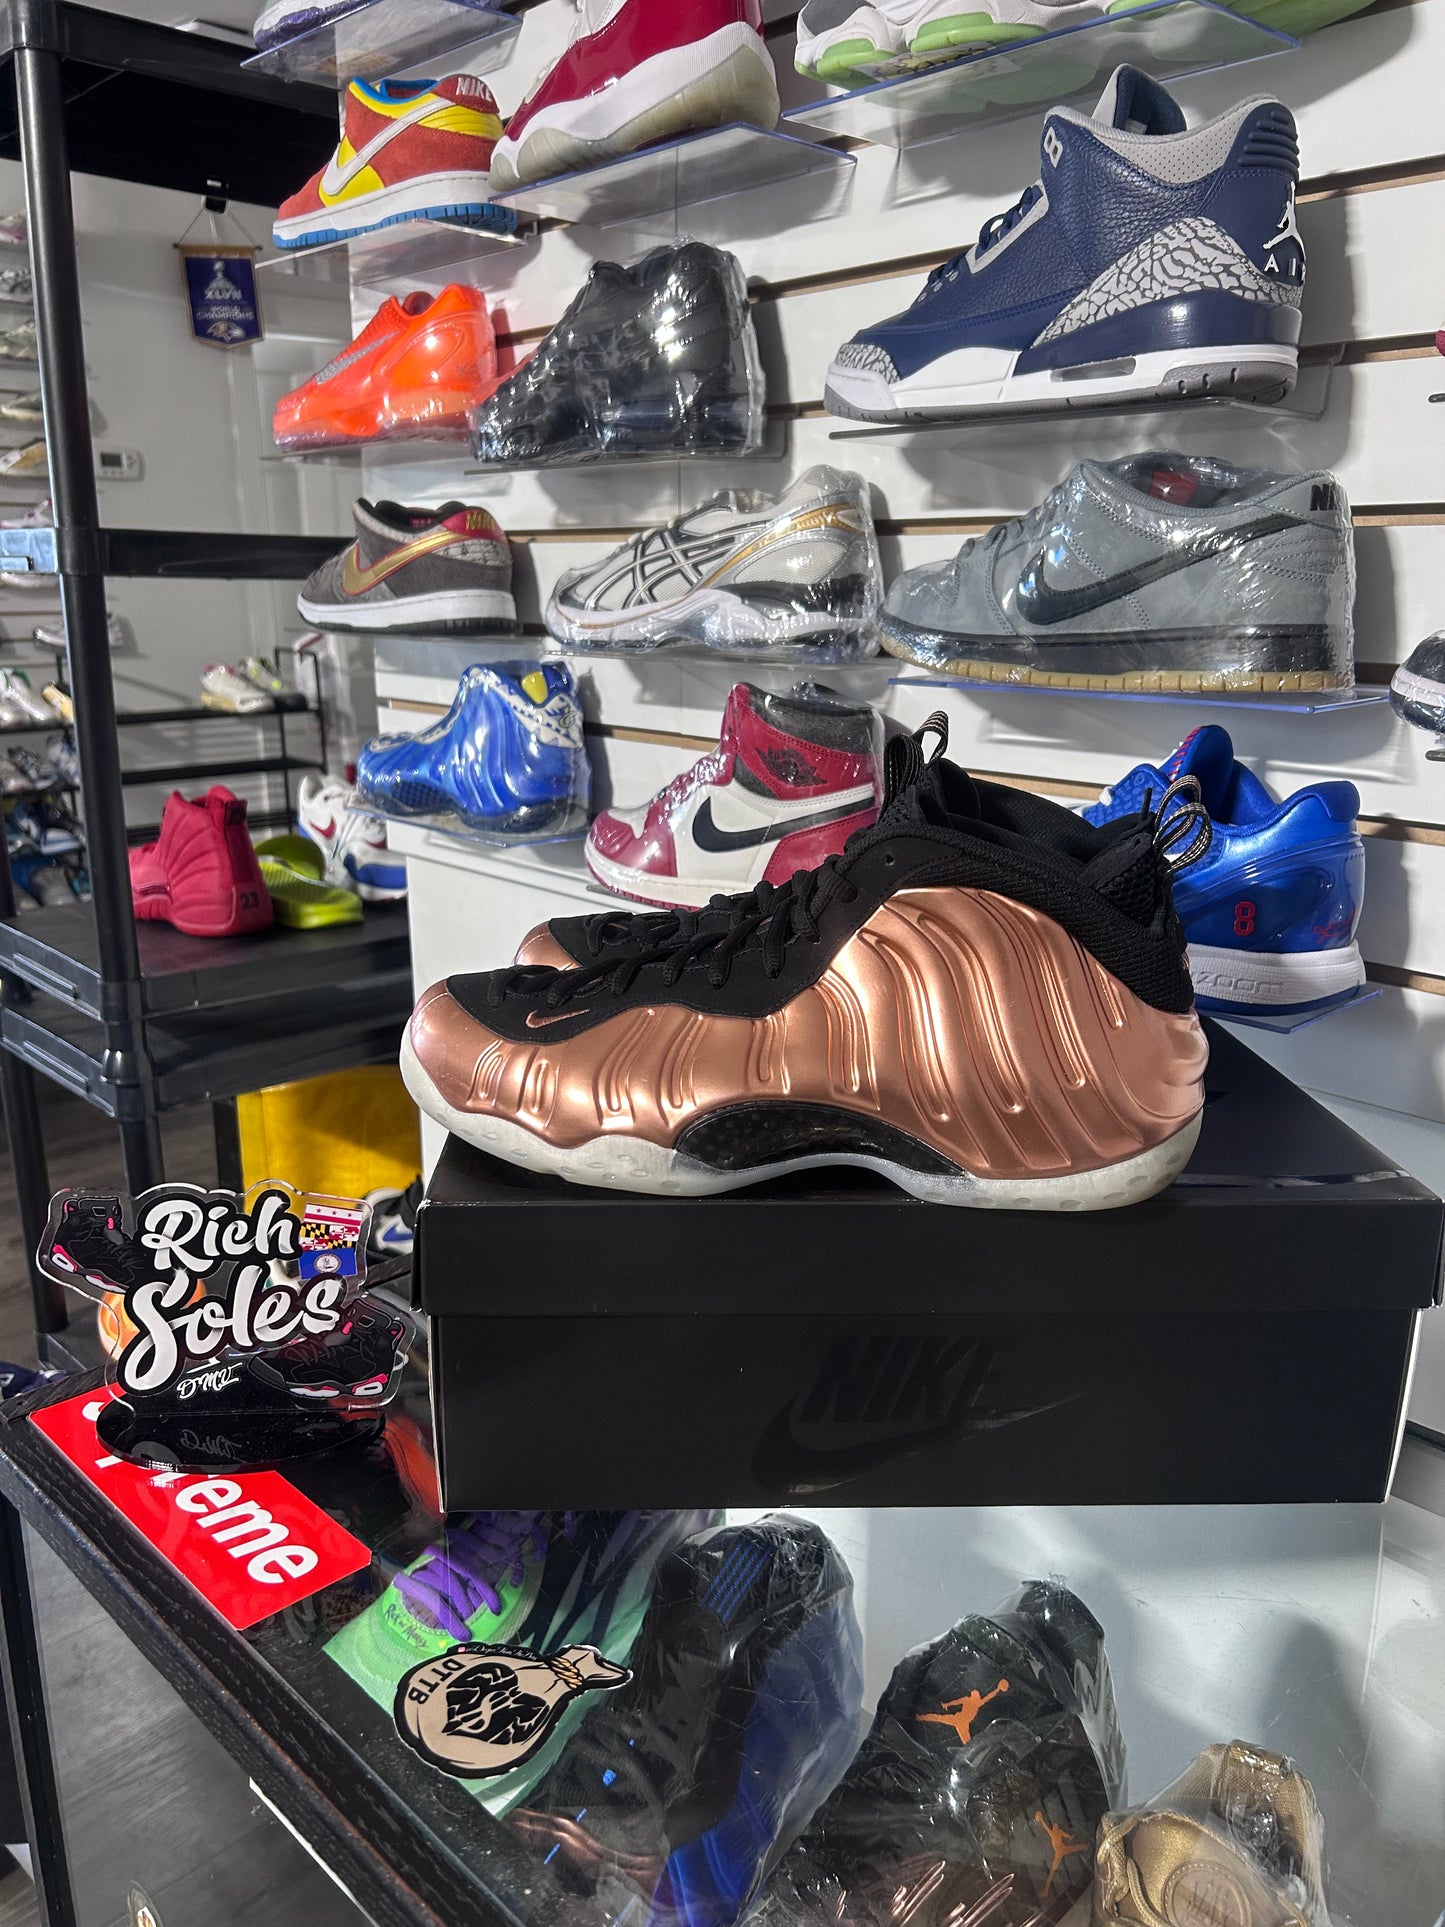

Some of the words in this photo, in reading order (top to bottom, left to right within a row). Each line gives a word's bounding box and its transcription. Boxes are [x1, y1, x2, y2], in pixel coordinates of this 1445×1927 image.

[456, 77, 493, 102] NIKE
[1263, 253, 1306, 284] AI
[1234, 901, 1256, 937] 8
[141, 1196, 295, 1272] Rich
[124, 1265, 341, 1391] Soles
[176, 1362, 243, 1399] DMV
[797, 1336, 1022, 1424] NIKE
[408, 1658, 466, 1705] DTTB
